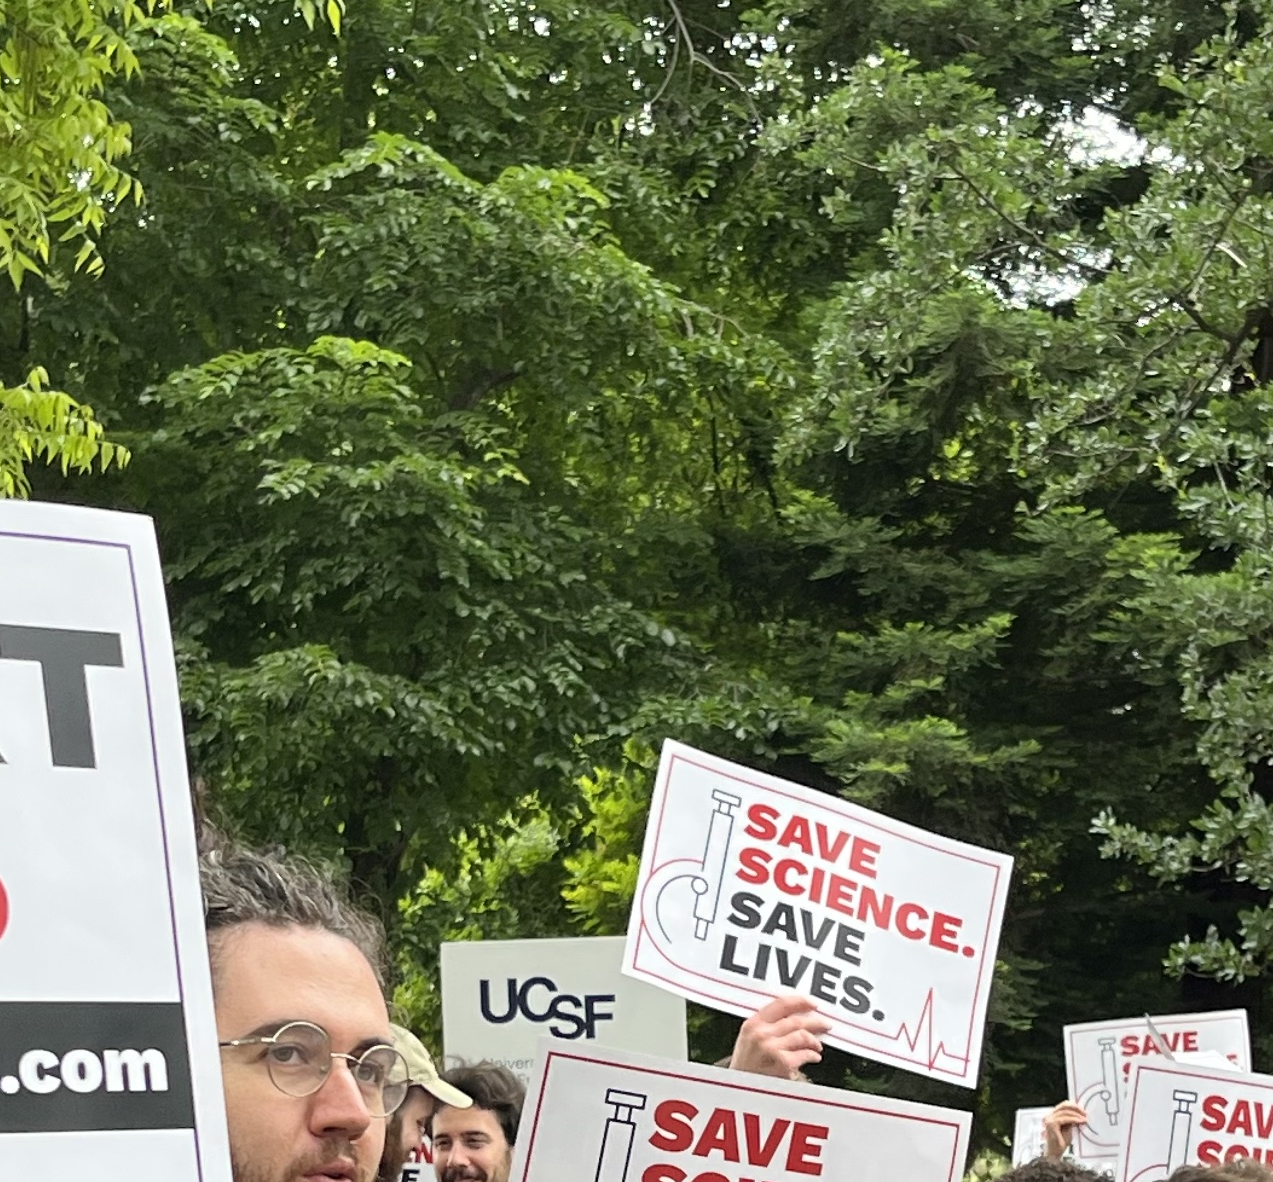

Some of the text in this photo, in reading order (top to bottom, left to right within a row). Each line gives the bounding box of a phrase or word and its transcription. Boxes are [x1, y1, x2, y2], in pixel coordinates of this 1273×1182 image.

[744, 803, 880, 879] SAVE
[727, 892, 864, 966] SAVE
[735, 848, 975, 958] SCIENCE.
[479, 976, 615, 1040] UCSF
[719, 934, 885, 1021] LIVES.
[1120, 1031, 1198, 1056] SAVE
[648, 1099, 828, 1176] SAVE
